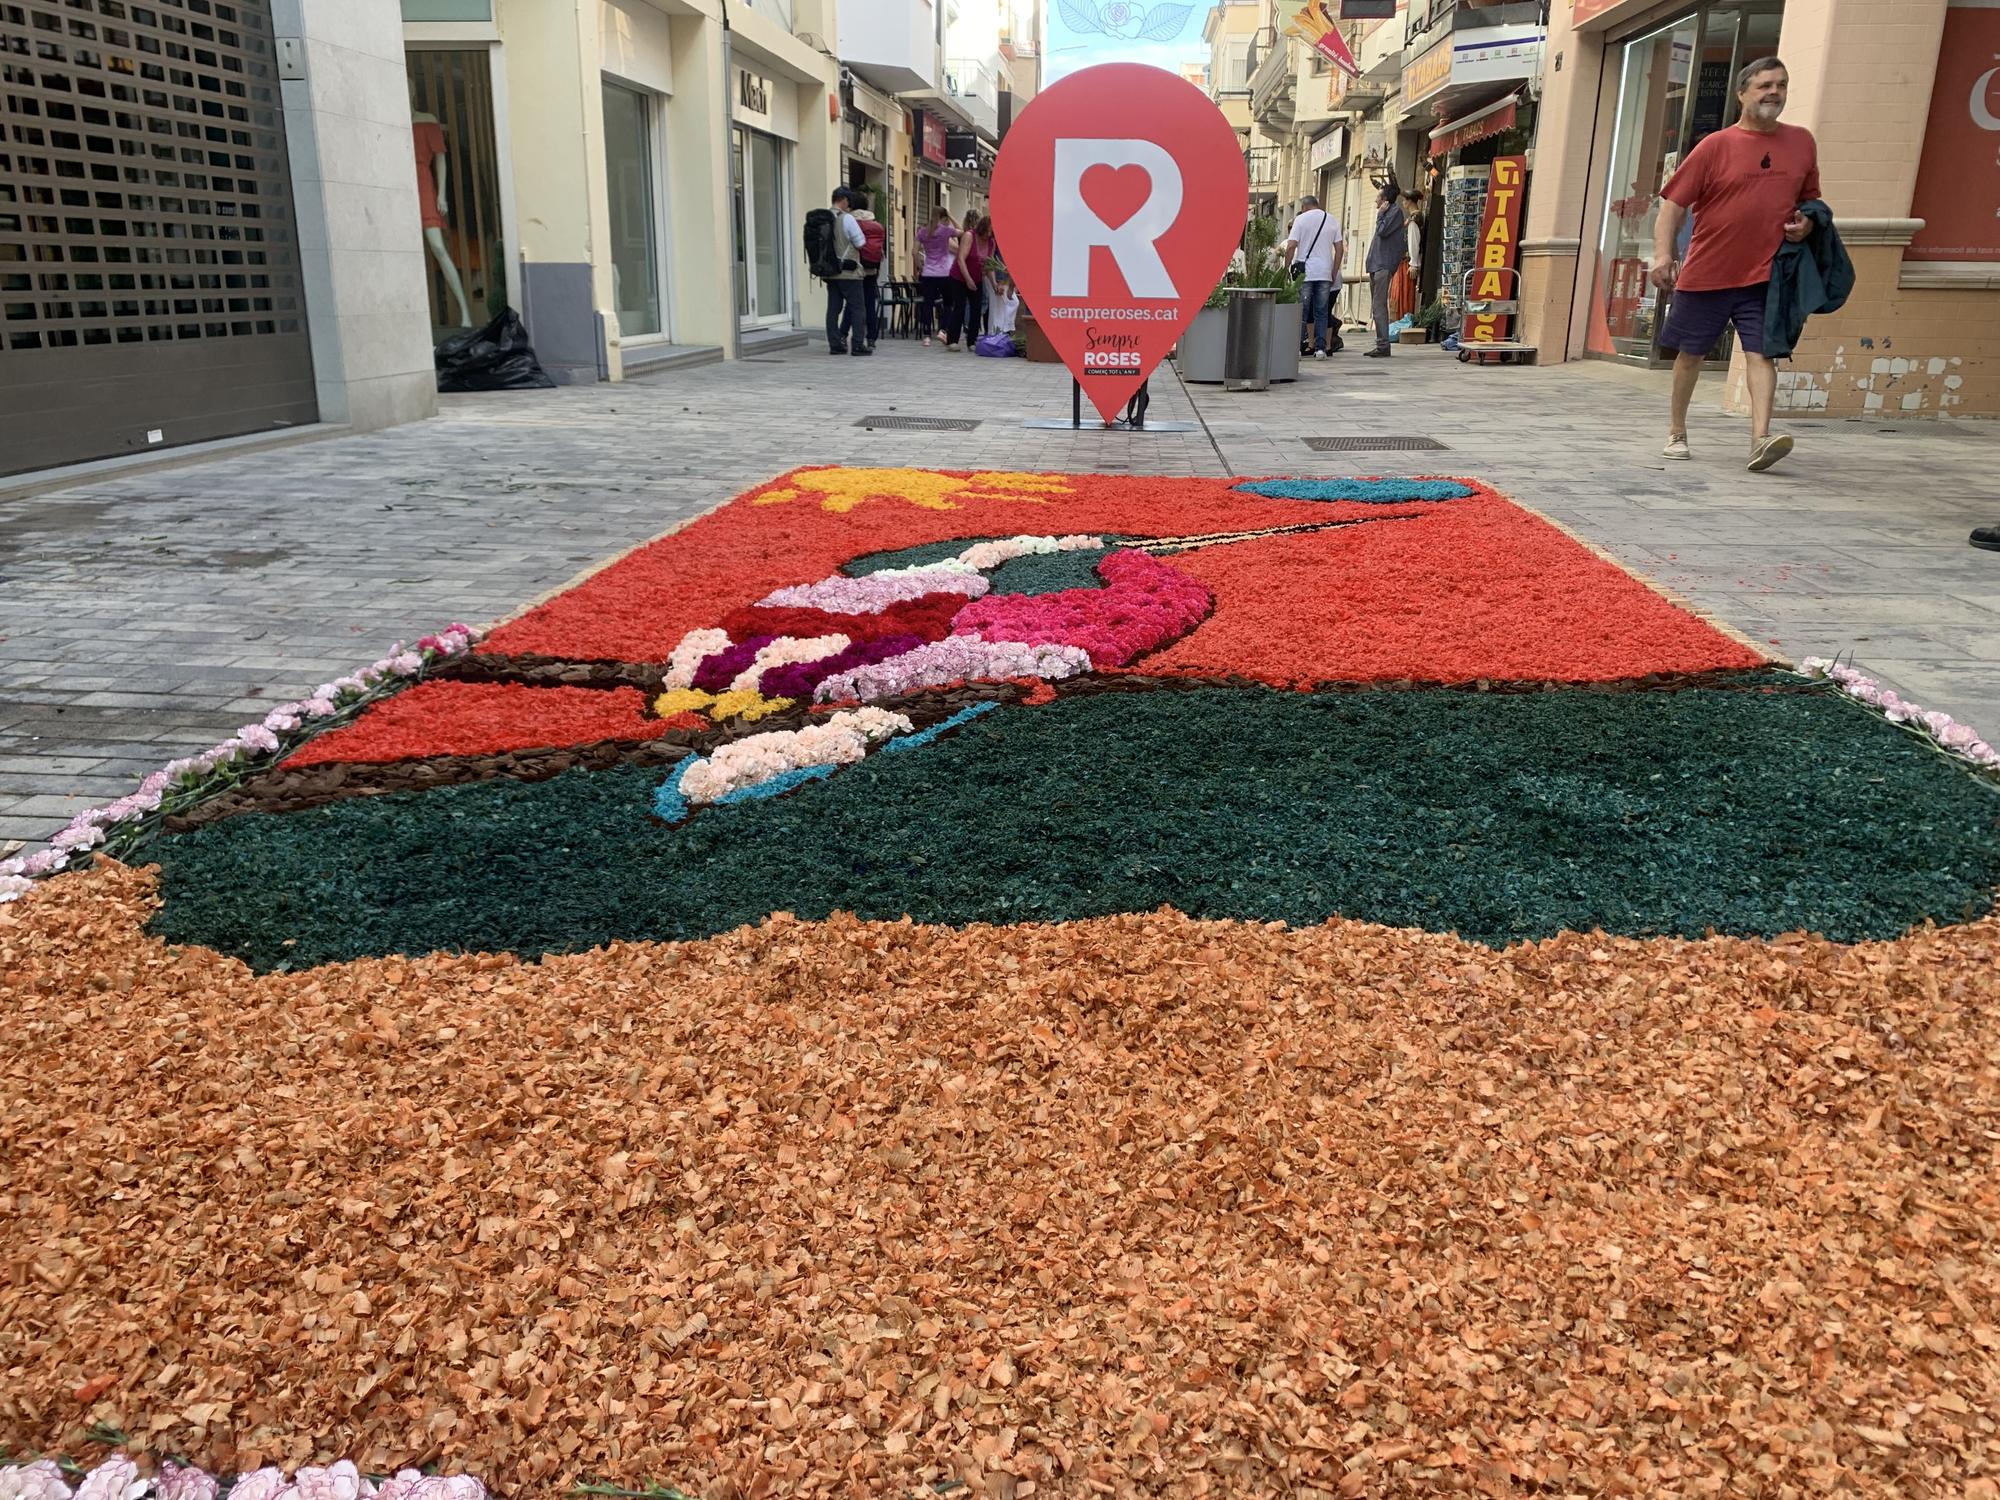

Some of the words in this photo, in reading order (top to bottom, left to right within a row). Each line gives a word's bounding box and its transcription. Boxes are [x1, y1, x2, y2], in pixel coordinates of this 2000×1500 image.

[1050, 307, 1178, 322] sempreroses.cat
[1086, 327, 1140, 351] Sempre
[1084, 352, 1141, 366] ROSES
